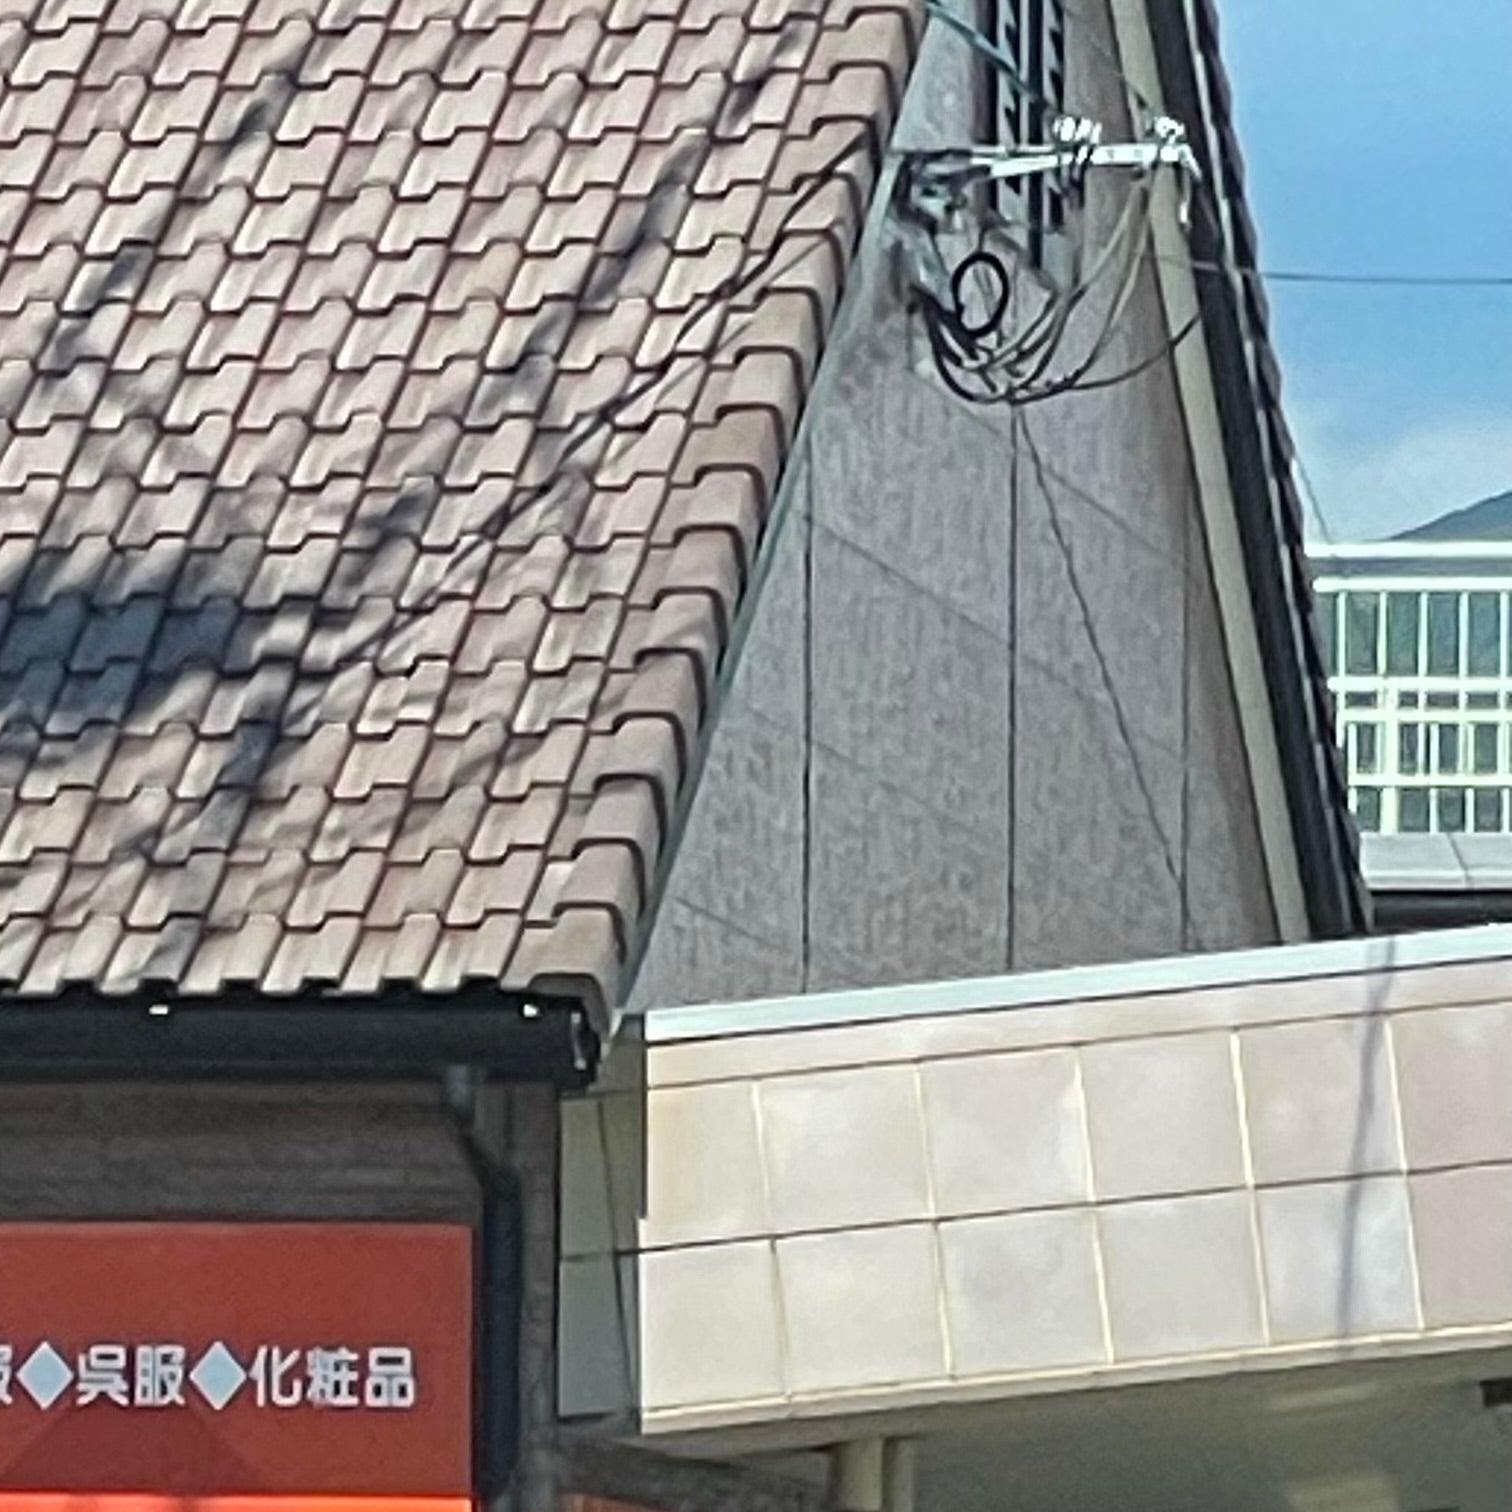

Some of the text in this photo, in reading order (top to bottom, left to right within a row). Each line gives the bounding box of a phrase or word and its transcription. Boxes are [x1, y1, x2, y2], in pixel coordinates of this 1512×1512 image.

[76, 1345, 186, 1408] 呉服
[250, 1346, 416, 1408] 化粧品
